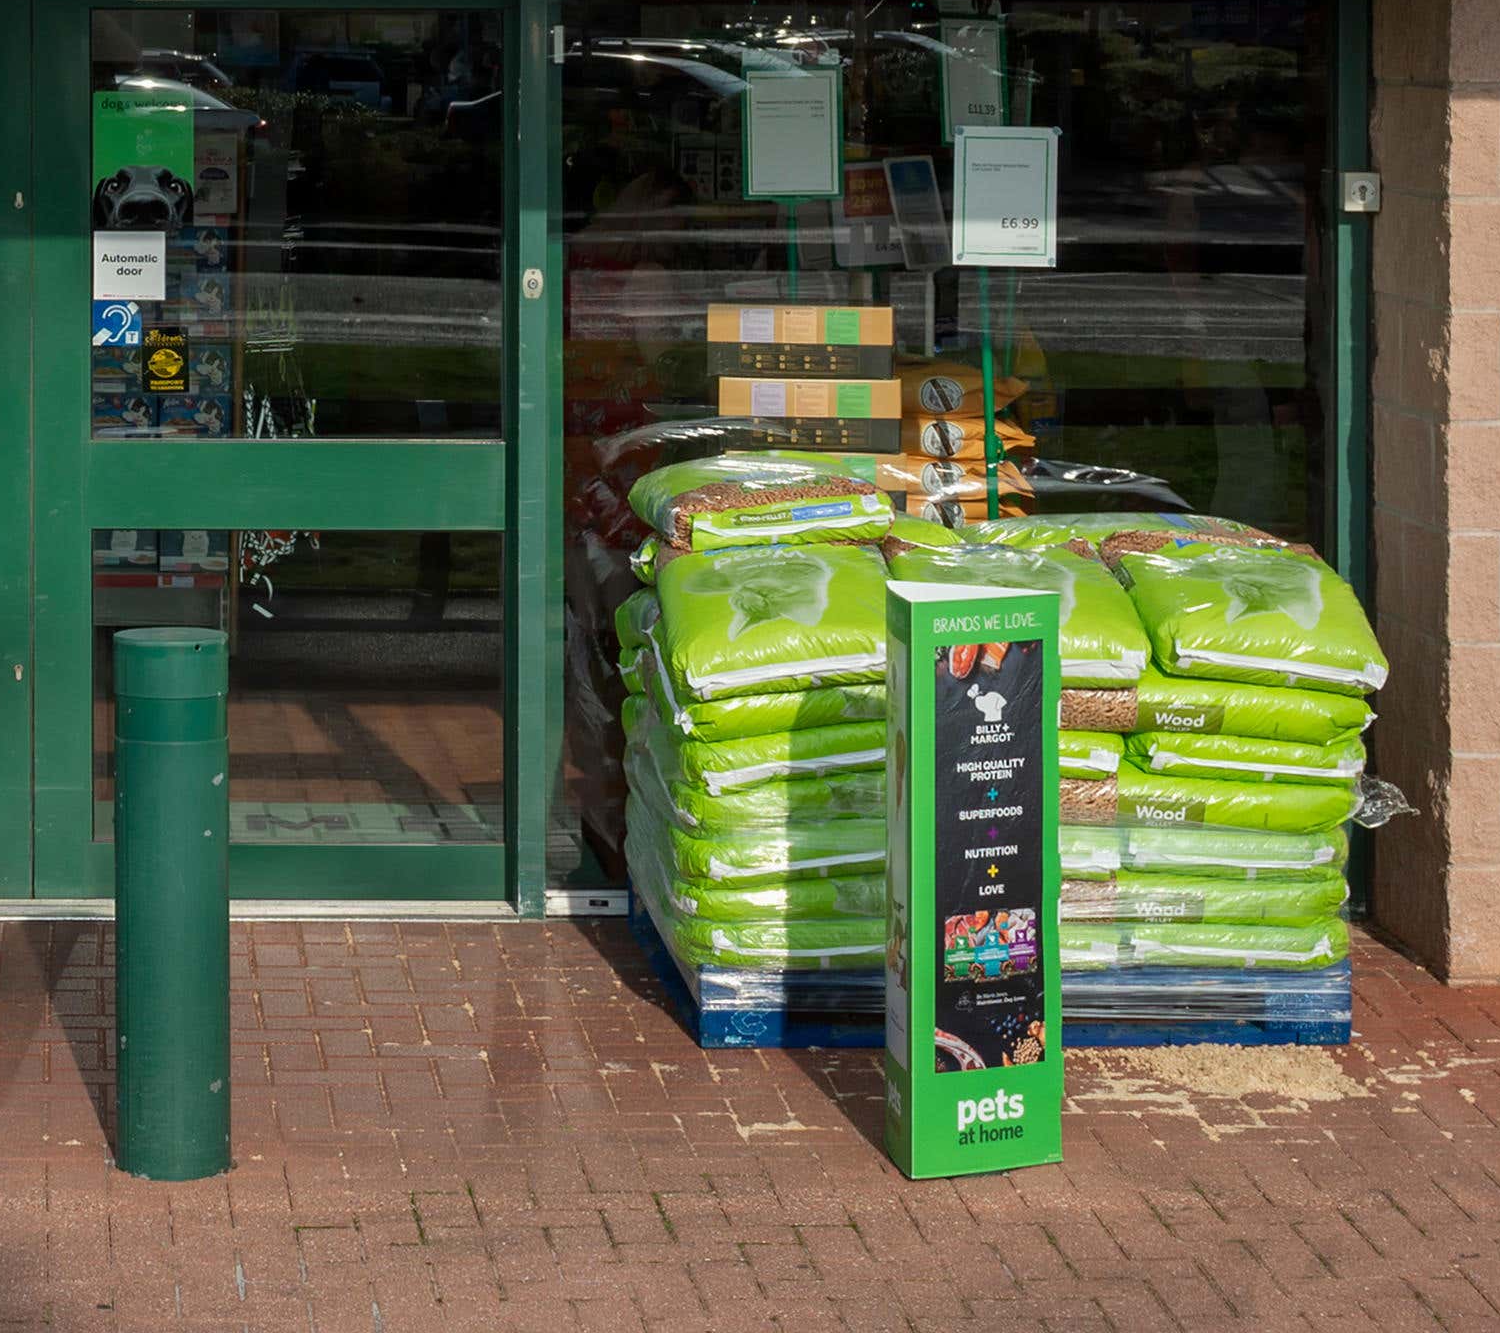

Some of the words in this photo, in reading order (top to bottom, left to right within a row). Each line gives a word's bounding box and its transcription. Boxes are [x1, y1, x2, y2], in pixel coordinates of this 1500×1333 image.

[101, 96, 131, 112] dogs
[1001, 217, 1039, 230] £6.99
[101, 253, 158, 264] Automatic
[116, 266, 143, 276] door
[130, 332, 136, 342] T
[933, 615, 981, 634] BRANDS
[983, 614, 1001, 630] WE
[1155, 712, 1206, 728] Wood
[1135, 804, 1187, 822] Wood
[1135, 901, 1186, 917] Wood
[957, 1088, 1025, 1132] pets
[958, 1126, 976, 1146] at
[978, 1123, 1024, 1143] home
